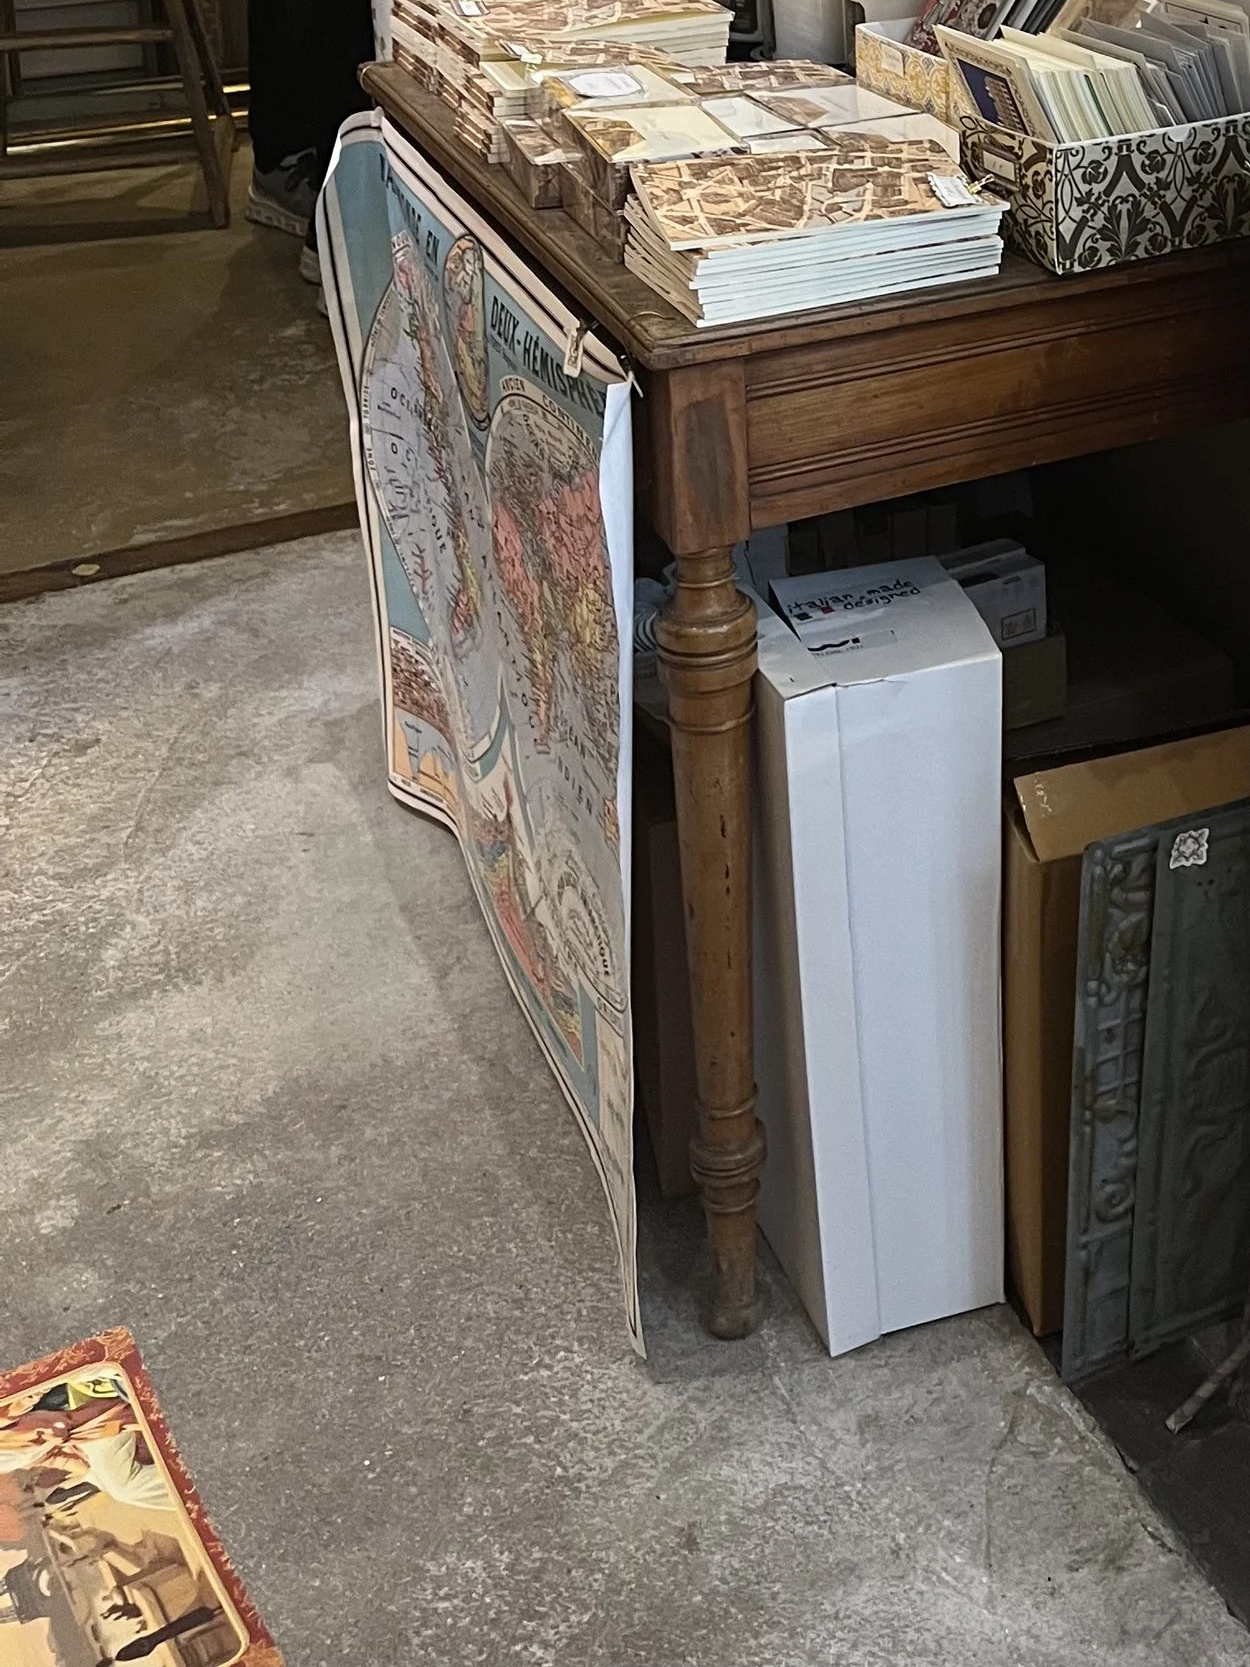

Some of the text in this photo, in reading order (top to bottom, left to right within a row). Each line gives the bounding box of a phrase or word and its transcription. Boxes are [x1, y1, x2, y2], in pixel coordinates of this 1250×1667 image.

[426, 230, 440, 265] EN
[843, 586, 921, 611] designed
[866, 578, 914, 596] made
